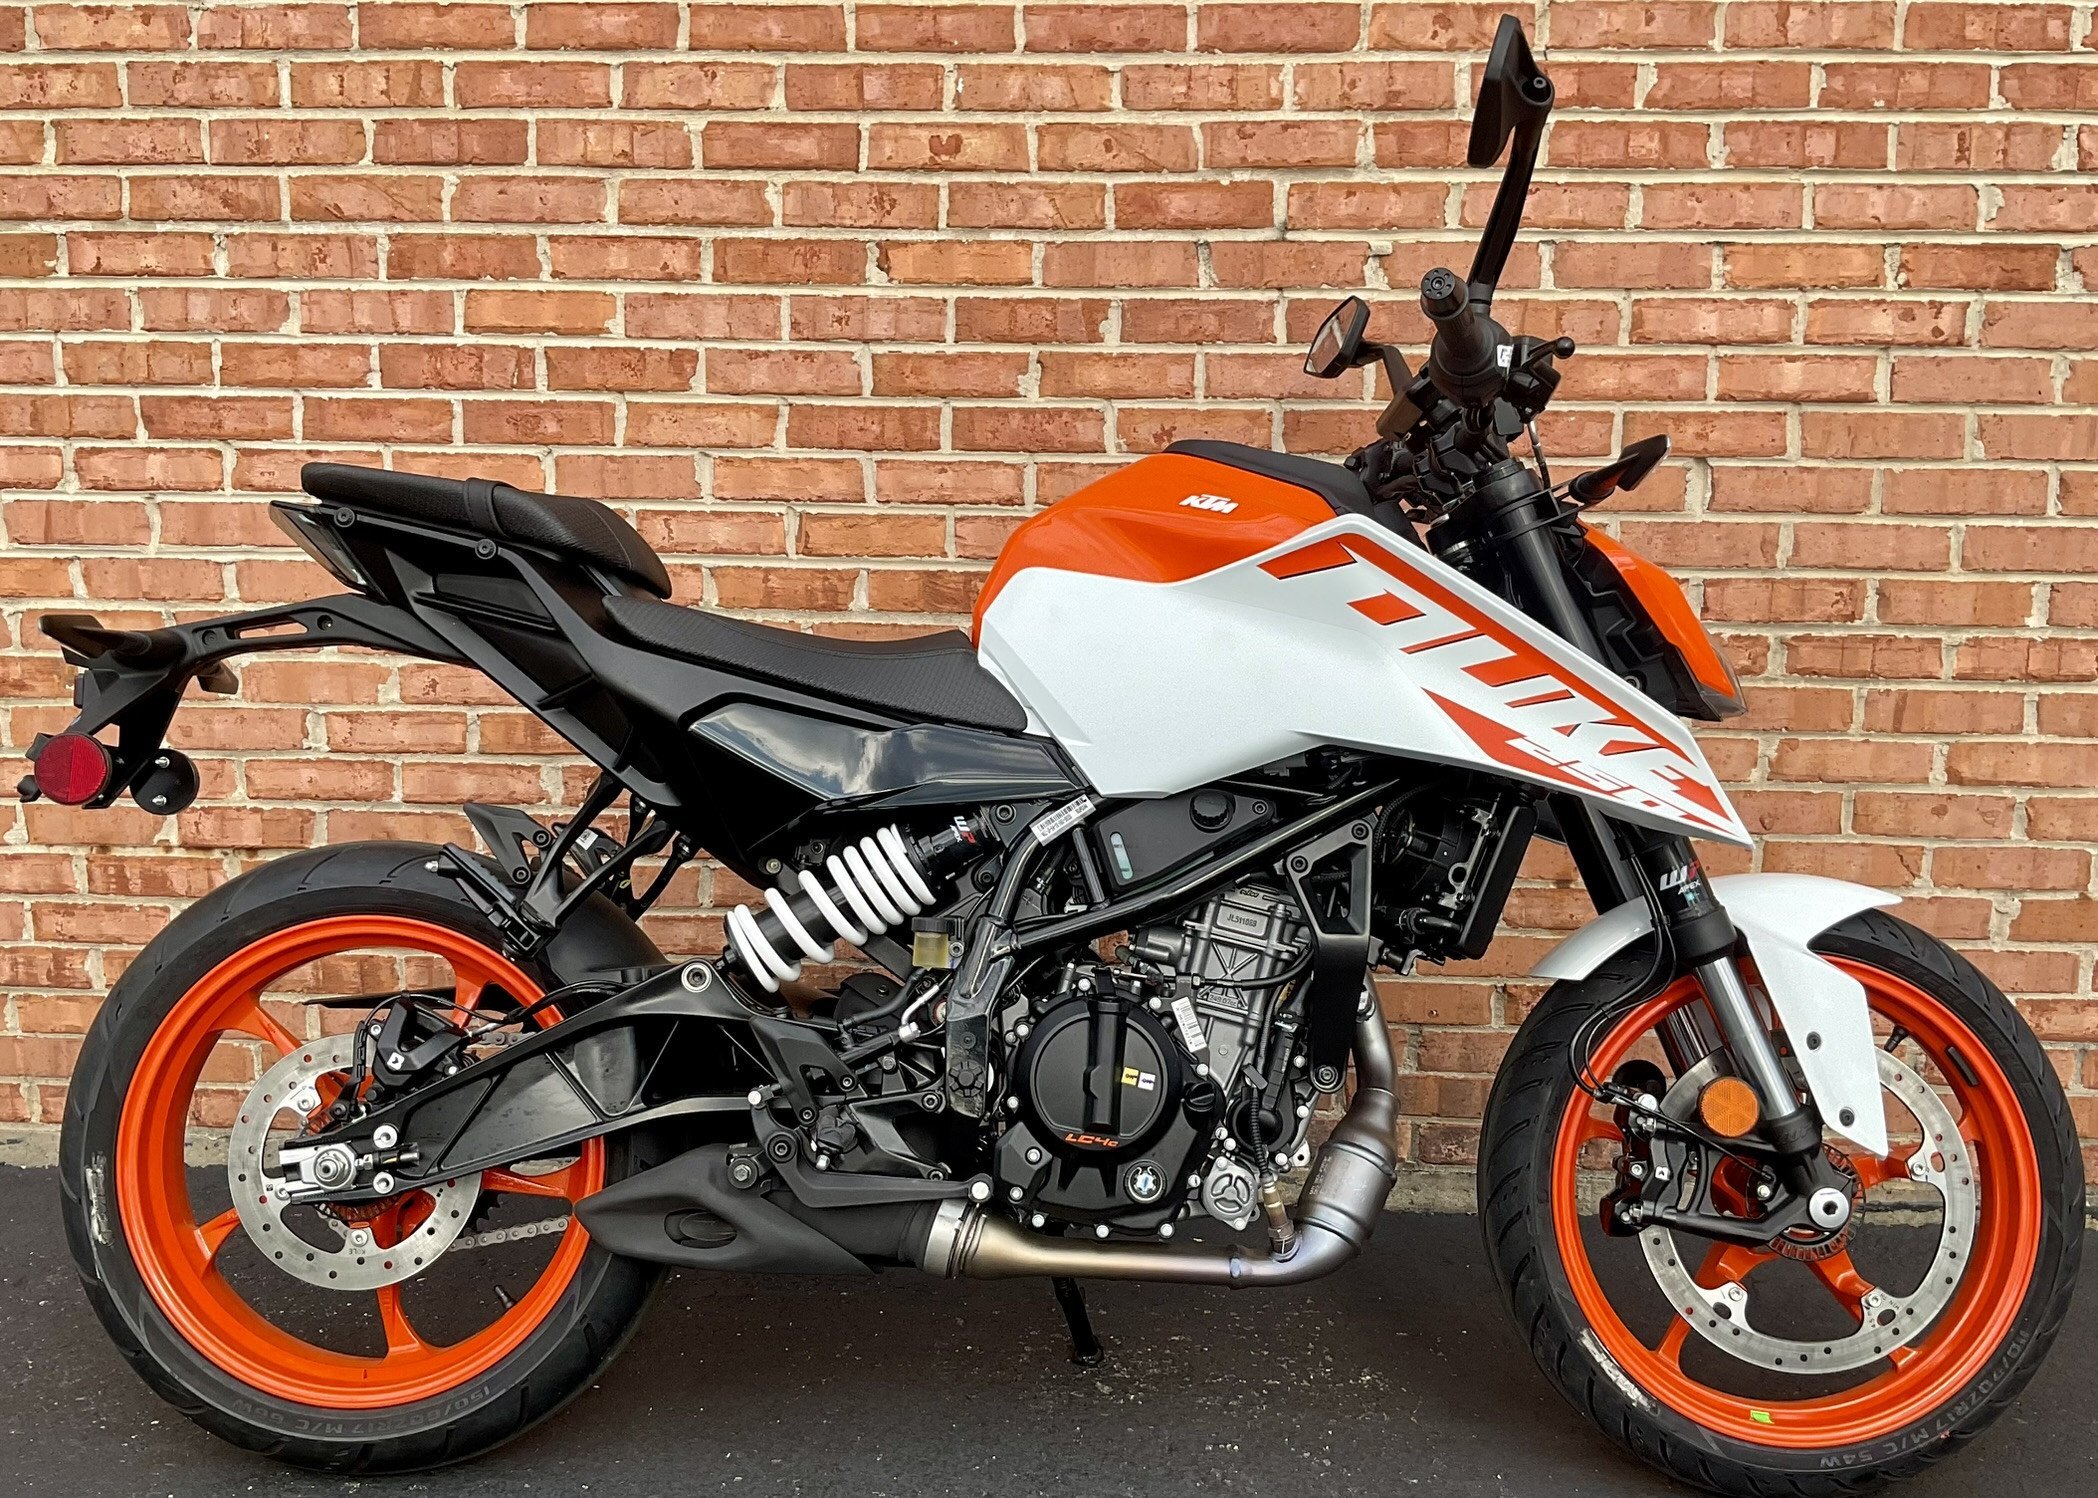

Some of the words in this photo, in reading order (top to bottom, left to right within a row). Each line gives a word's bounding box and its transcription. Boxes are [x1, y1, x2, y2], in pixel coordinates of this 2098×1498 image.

[1179, 494, 1239, 514] KTM
[1277, 542, 1715, 812] DUKE
[1504, 735, 1690, 824] 250
[1677, 879, 1701, 895] APEX
[297, 1419, 343, 1434] M/C
[1882, 1427, 1929, 1455] M/C
[1820, 1450, 1873, 1468] 54W
